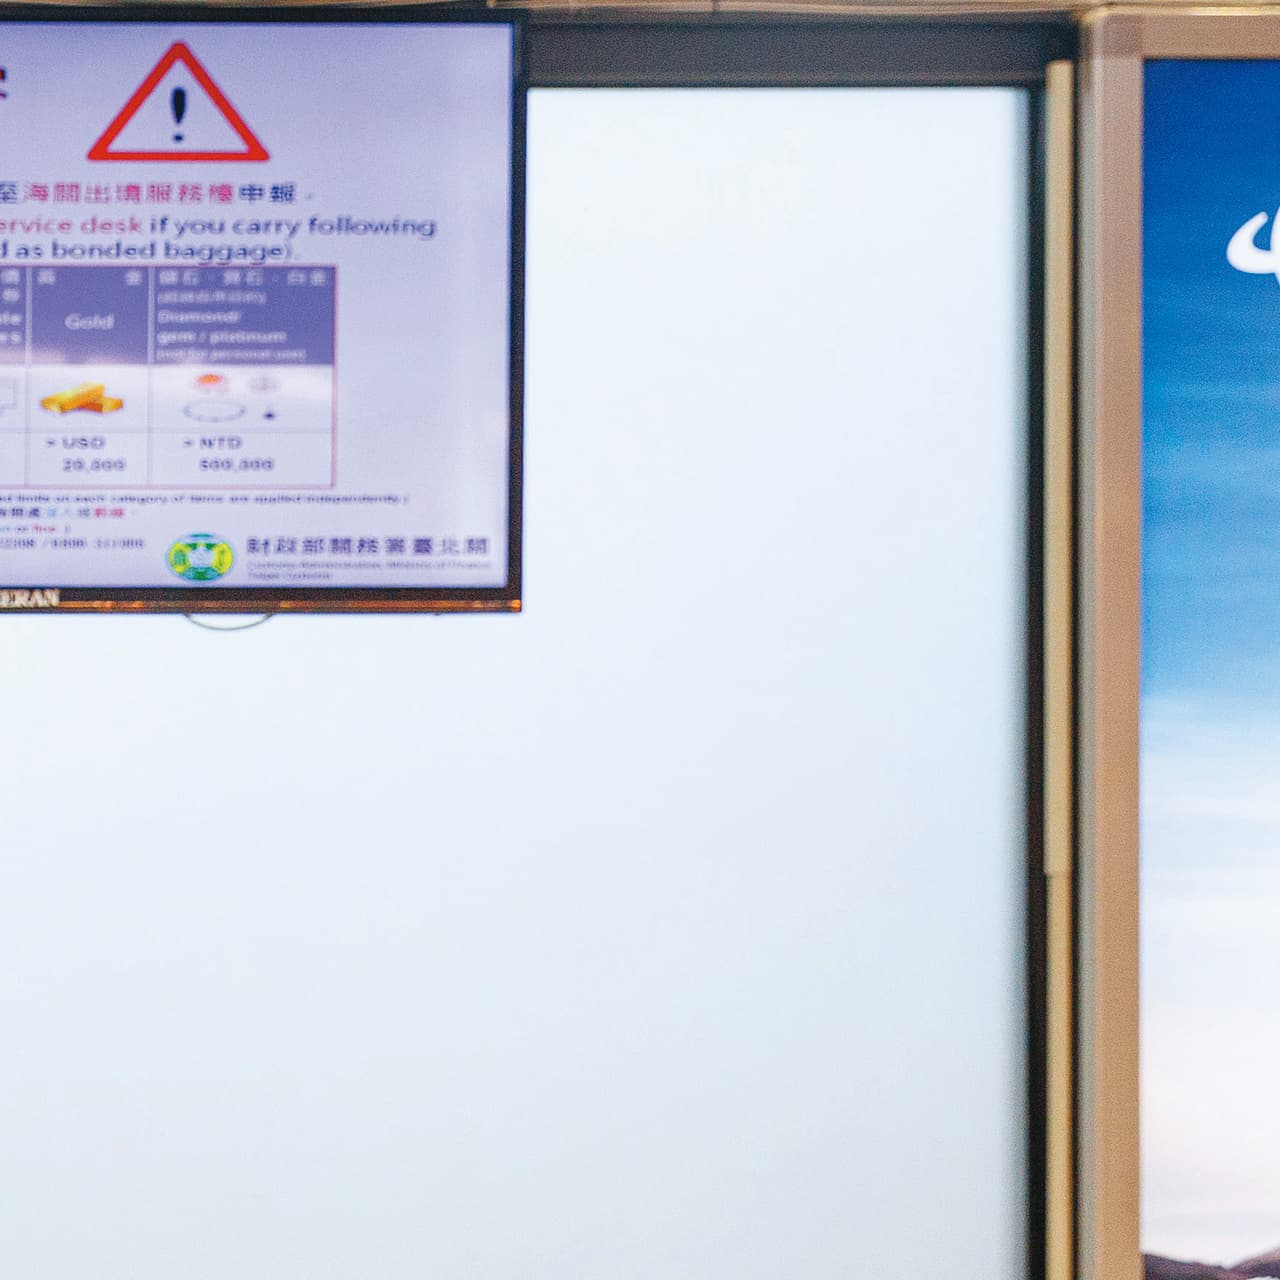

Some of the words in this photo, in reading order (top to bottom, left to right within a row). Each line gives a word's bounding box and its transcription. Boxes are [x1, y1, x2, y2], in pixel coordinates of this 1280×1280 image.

[80, 215, 141, 234] desk
[150, 215, 169, 234] if
[174, 220, 226, 237] you
[233, 220, 301, 237] carry
[309, 215, 437, 238] following
[16, 244, 42, 259] as
[51, 240, 155, 259] bonded
[164, 241, 301, 264] baggage).
[65, 314, 115, 330] Gold
